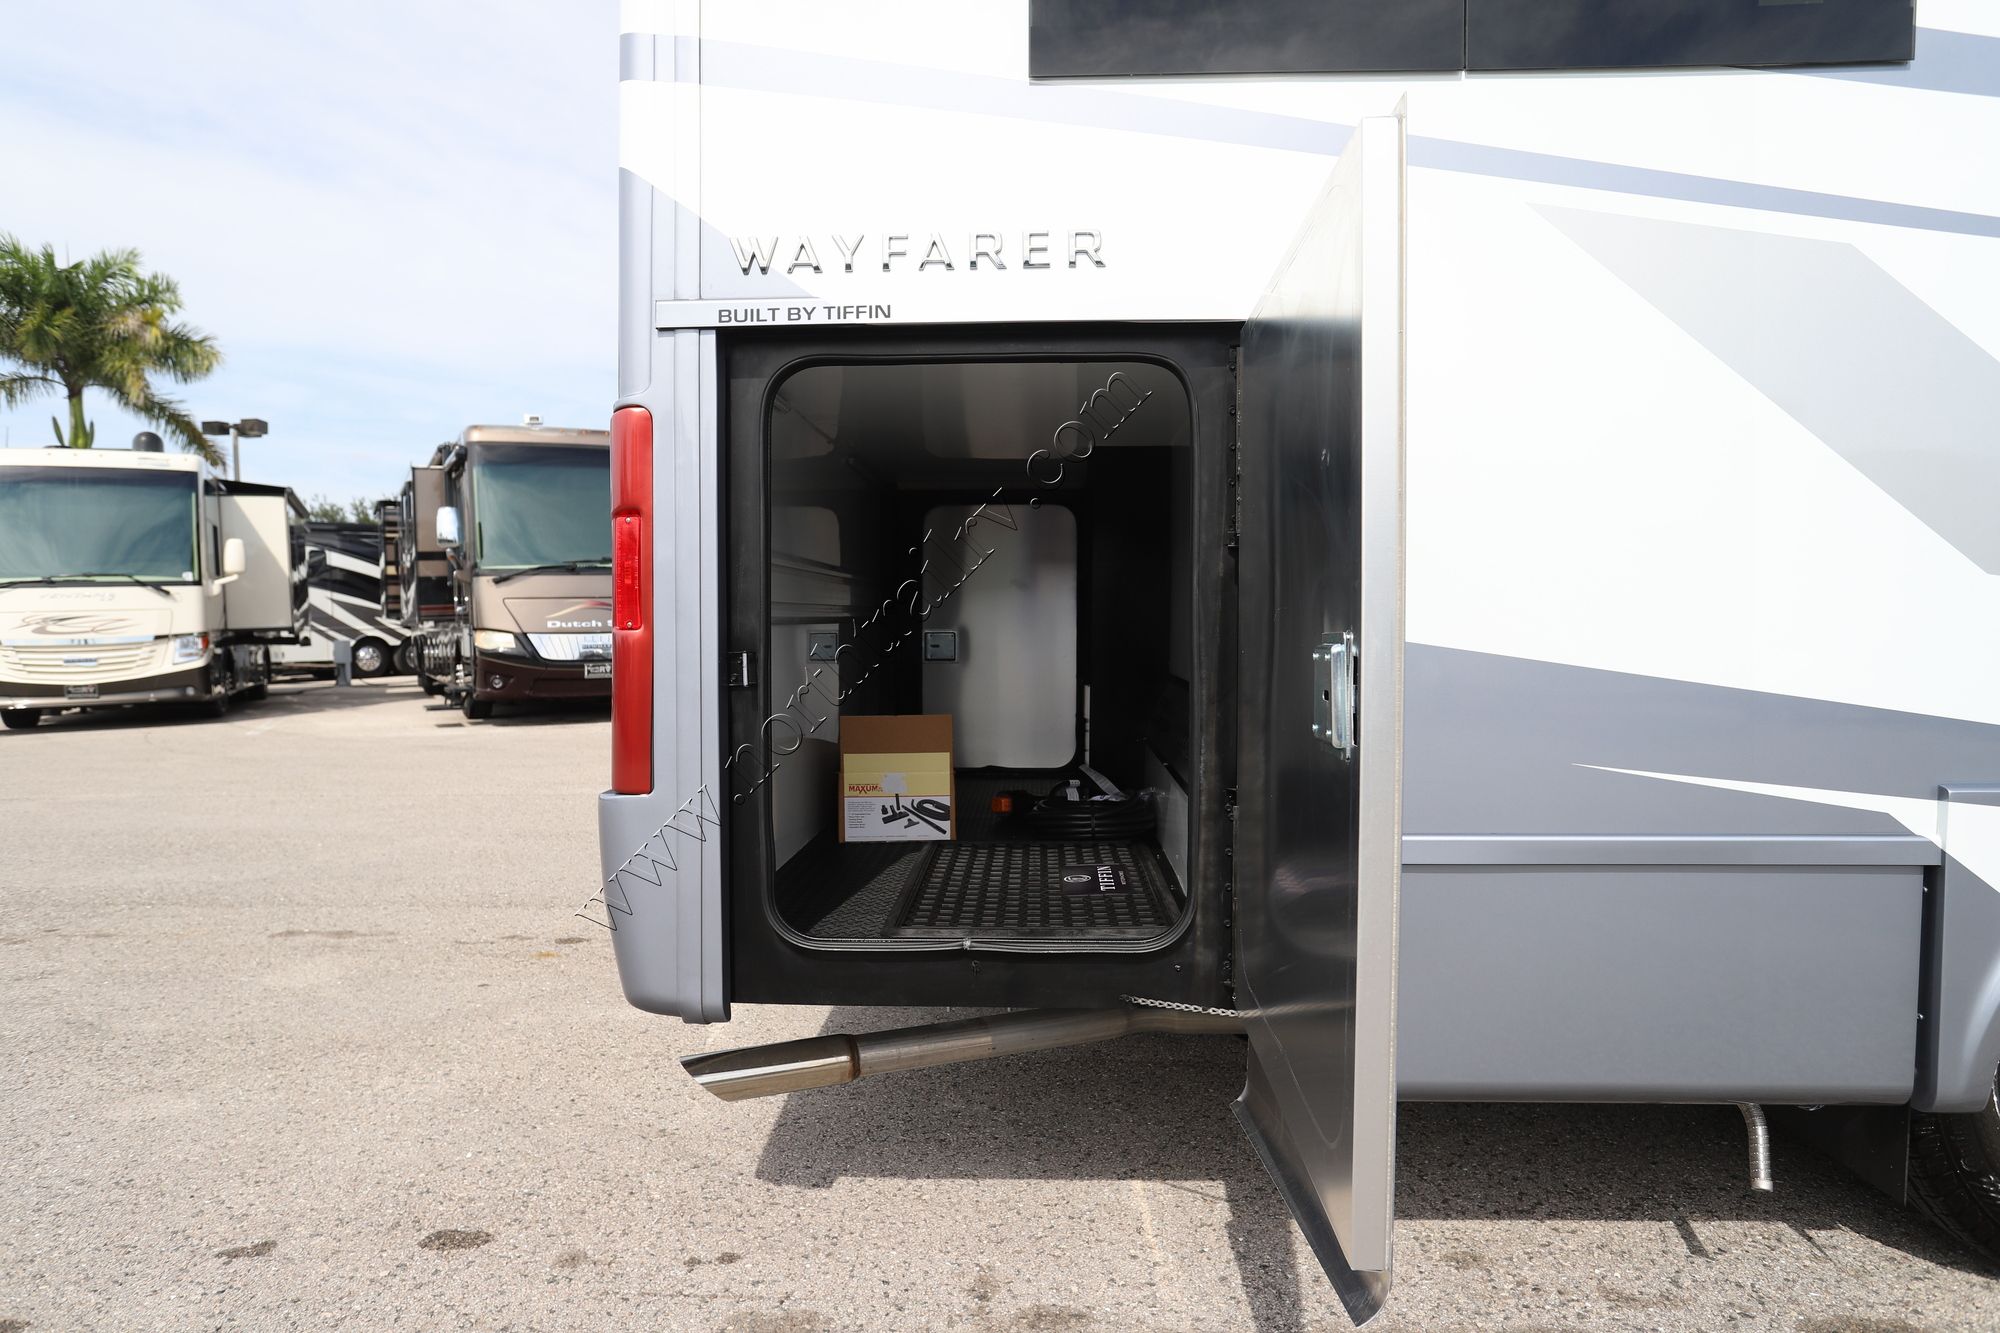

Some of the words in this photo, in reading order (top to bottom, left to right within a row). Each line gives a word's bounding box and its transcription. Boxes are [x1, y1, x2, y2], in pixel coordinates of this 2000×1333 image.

[729, 229, 1107, 276] WAYFARER
[717, 307, 780, 324] BUILT
[787, 306, 817, 323] BY
[823, 304, 892, 321] TIFFIN
[547, 620, 602, 629] Dutch
[848, 785, 878, 794] MAXUM
[1097, 866, 1115, 891] TIFFIN
